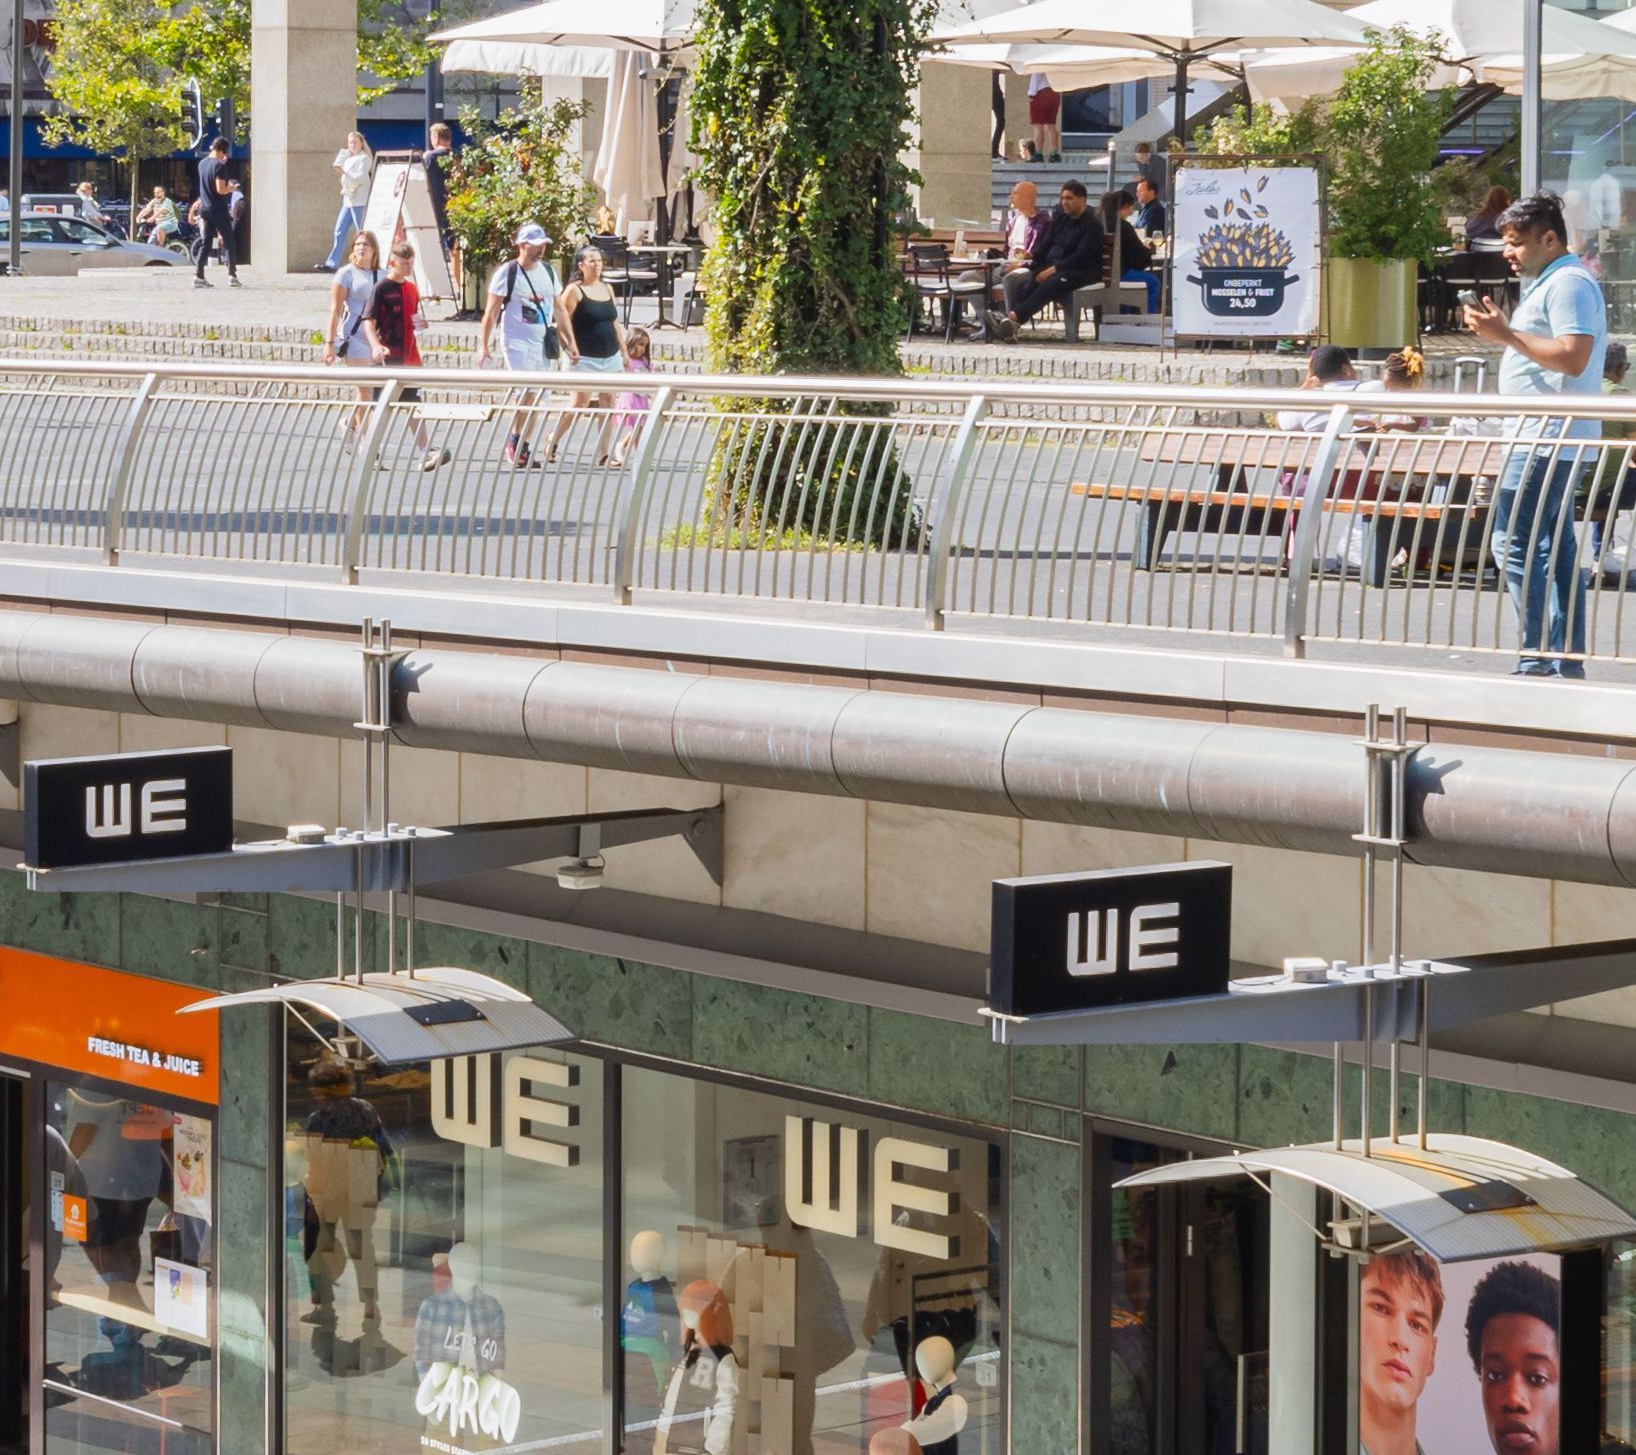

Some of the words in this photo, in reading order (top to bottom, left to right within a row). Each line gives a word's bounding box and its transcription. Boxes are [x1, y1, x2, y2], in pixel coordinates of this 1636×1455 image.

[86, 779, 186, 838] WE
[1066, 902, 1181, 977] WE
[87, 1036, 125, 1060] FRESH
[126, 1045, 150, 1066] TEA
[151, 1051, 162, 1068] &
[163, 1054, 201, 1077] JUICE
[430, 1053, 580, 1169] WE
[785, 1115, 960, 1260] WE
[481, 1338, 498, 1363] GO
[415, 1362, 522, 1445] CARGO
[430, 1438, 451, 1454] STYLES
